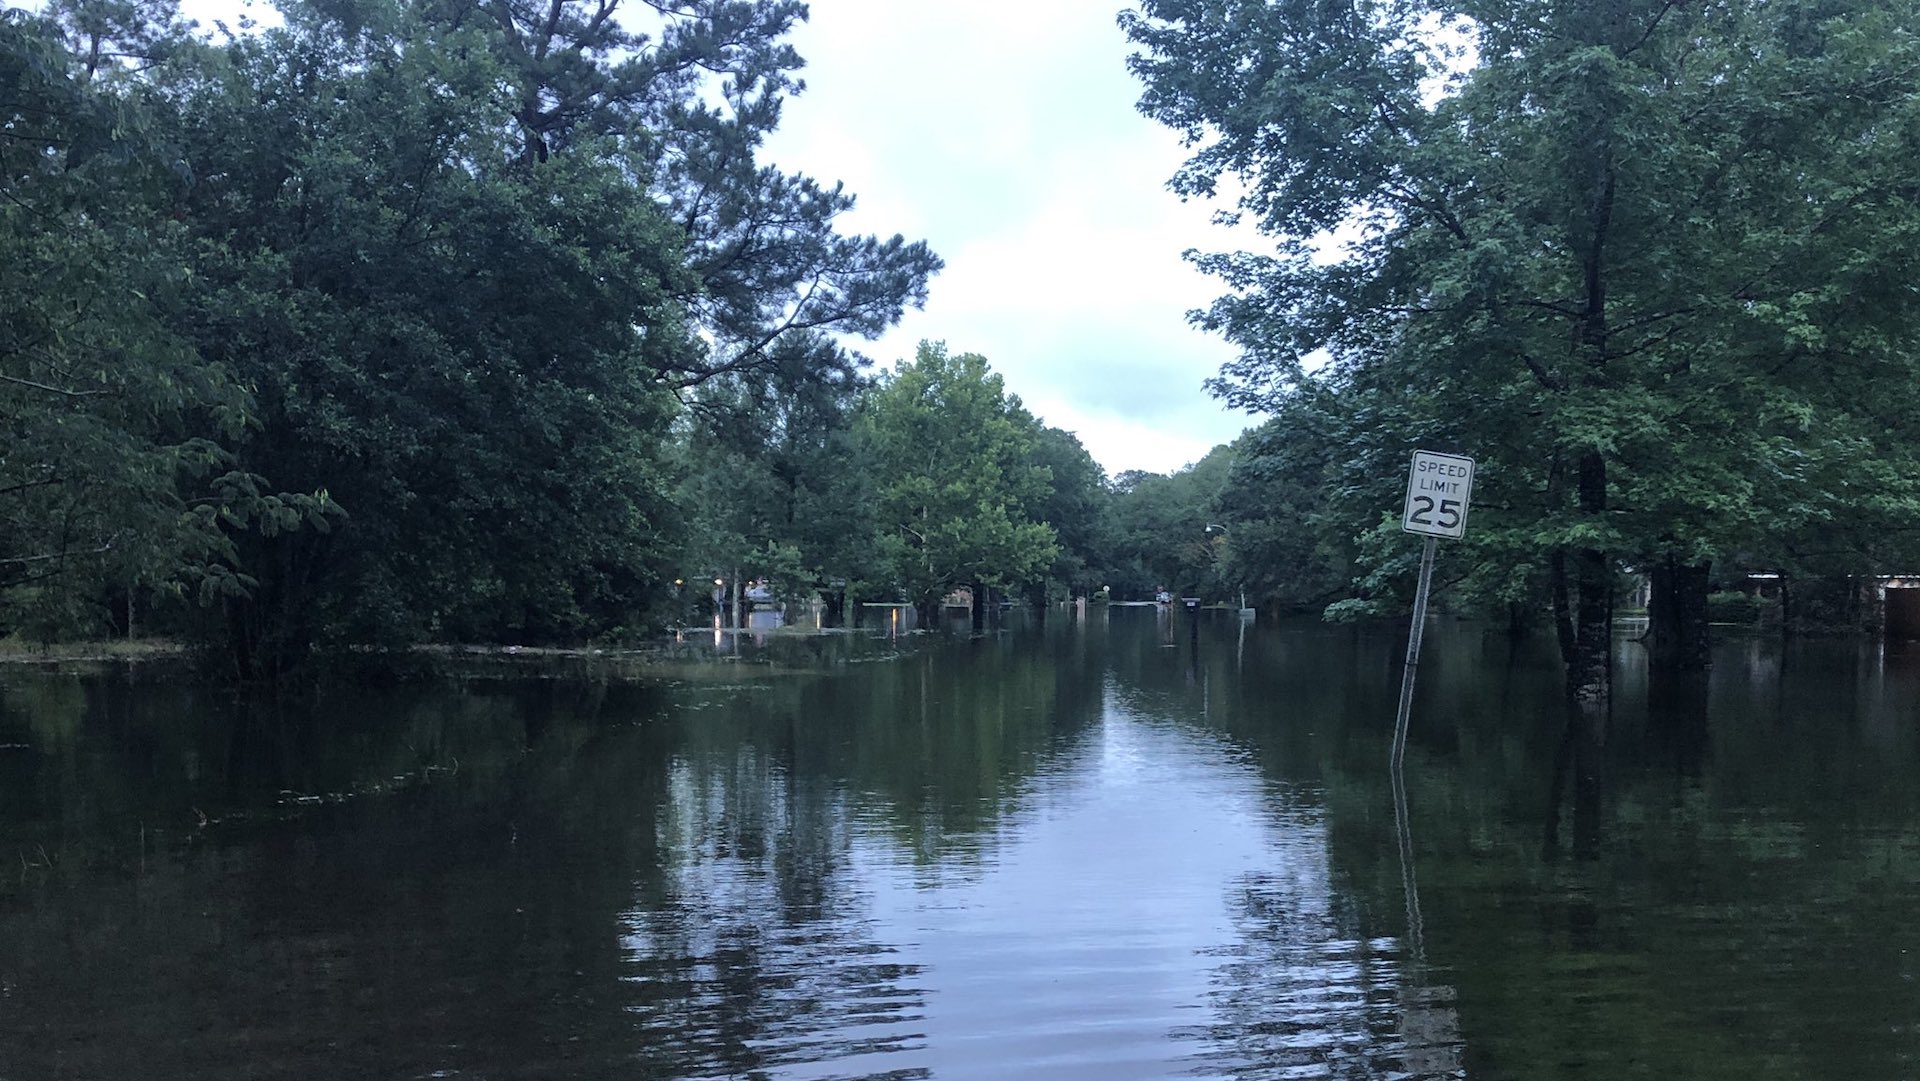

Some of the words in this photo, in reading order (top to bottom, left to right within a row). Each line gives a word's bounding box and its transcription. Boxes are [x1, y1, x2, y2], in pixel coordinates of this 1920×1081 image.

[1418, 461, 1467, 478] SPEED
[1420, 479, 1460, 494] LIMIT
[1410, 496, 1461, 529] 25
